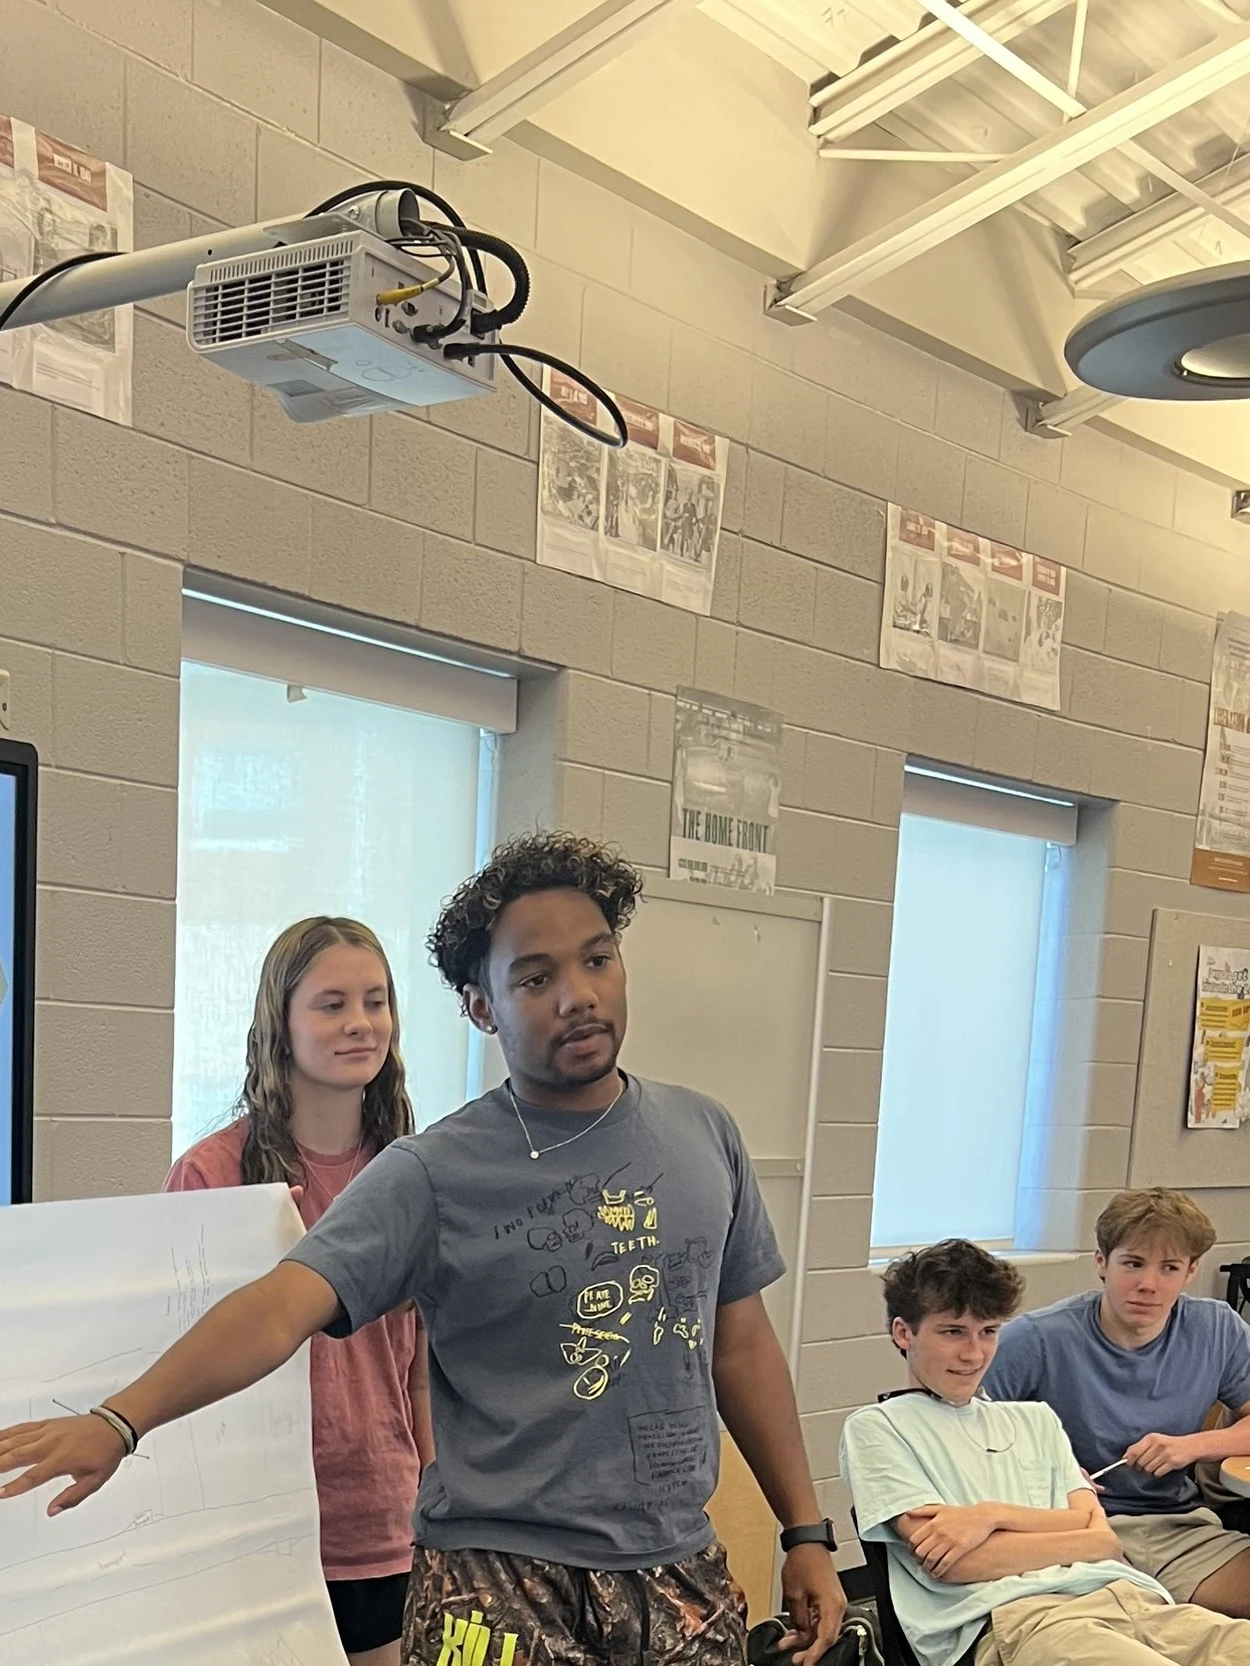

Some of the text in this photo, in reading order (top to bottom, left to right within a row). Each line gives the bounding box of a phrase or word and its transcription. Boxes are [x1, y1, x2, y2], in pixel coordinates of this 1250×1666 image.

[682, 807, 769, 854] THE HOME FRONT
